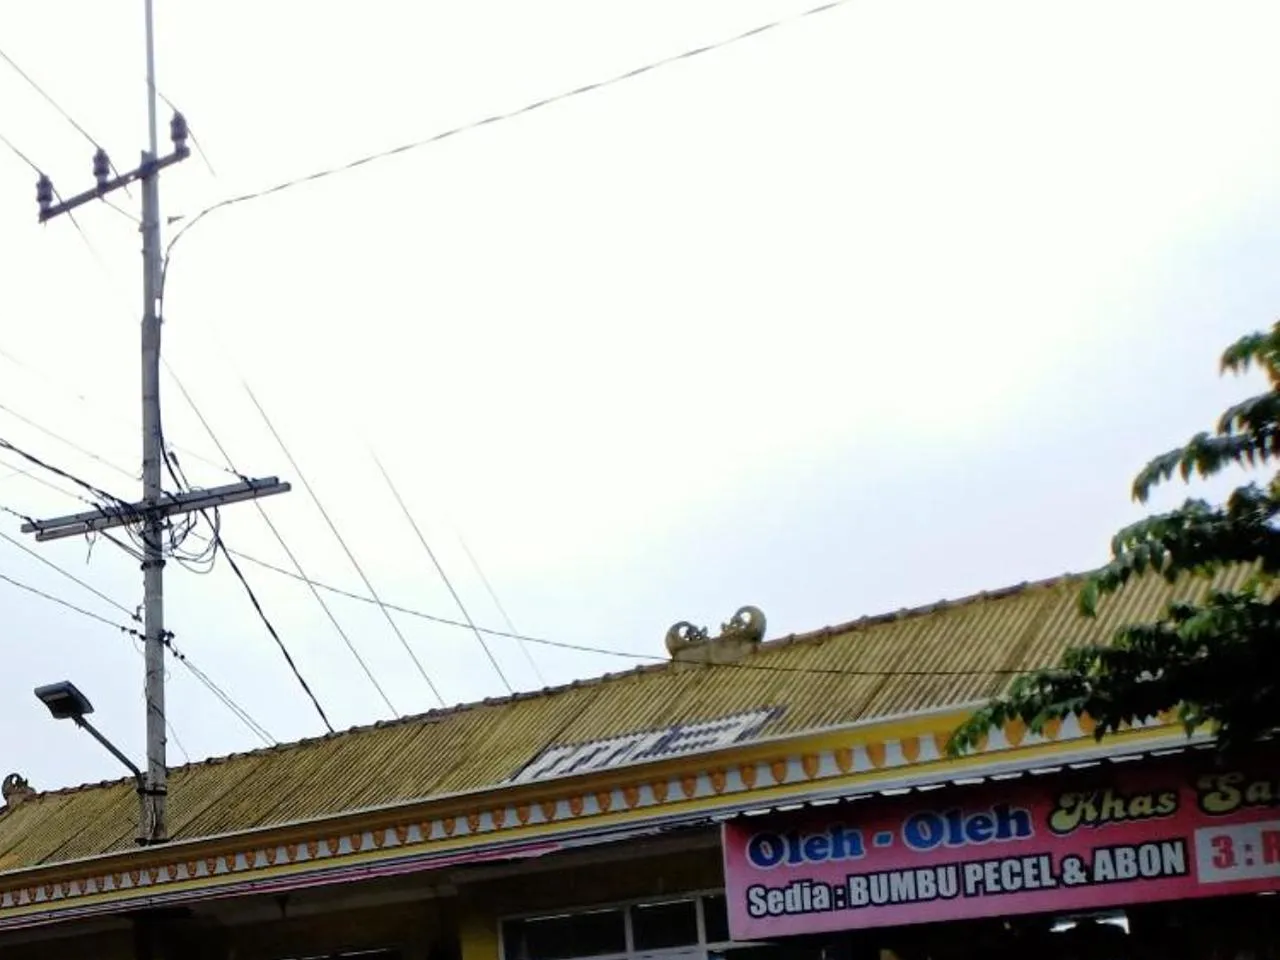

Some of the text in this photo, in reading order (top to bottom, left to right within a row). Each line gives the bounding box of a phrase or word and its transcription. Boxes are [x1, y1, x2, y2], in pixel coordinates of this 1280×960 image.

[747, 824, 865, 868] Oleh
[903, 804, 1032, 851] Oleh
[1049, 788, 1178, 834] Khas
[1196, 771, 1280, 815] Sa
[848, 865, 959, 908] BUMBU
[963, 853, 1057, 896] PECEL
[1061, 855, 1087, 885] &
[1093, 841, 1187, 881] ABON
